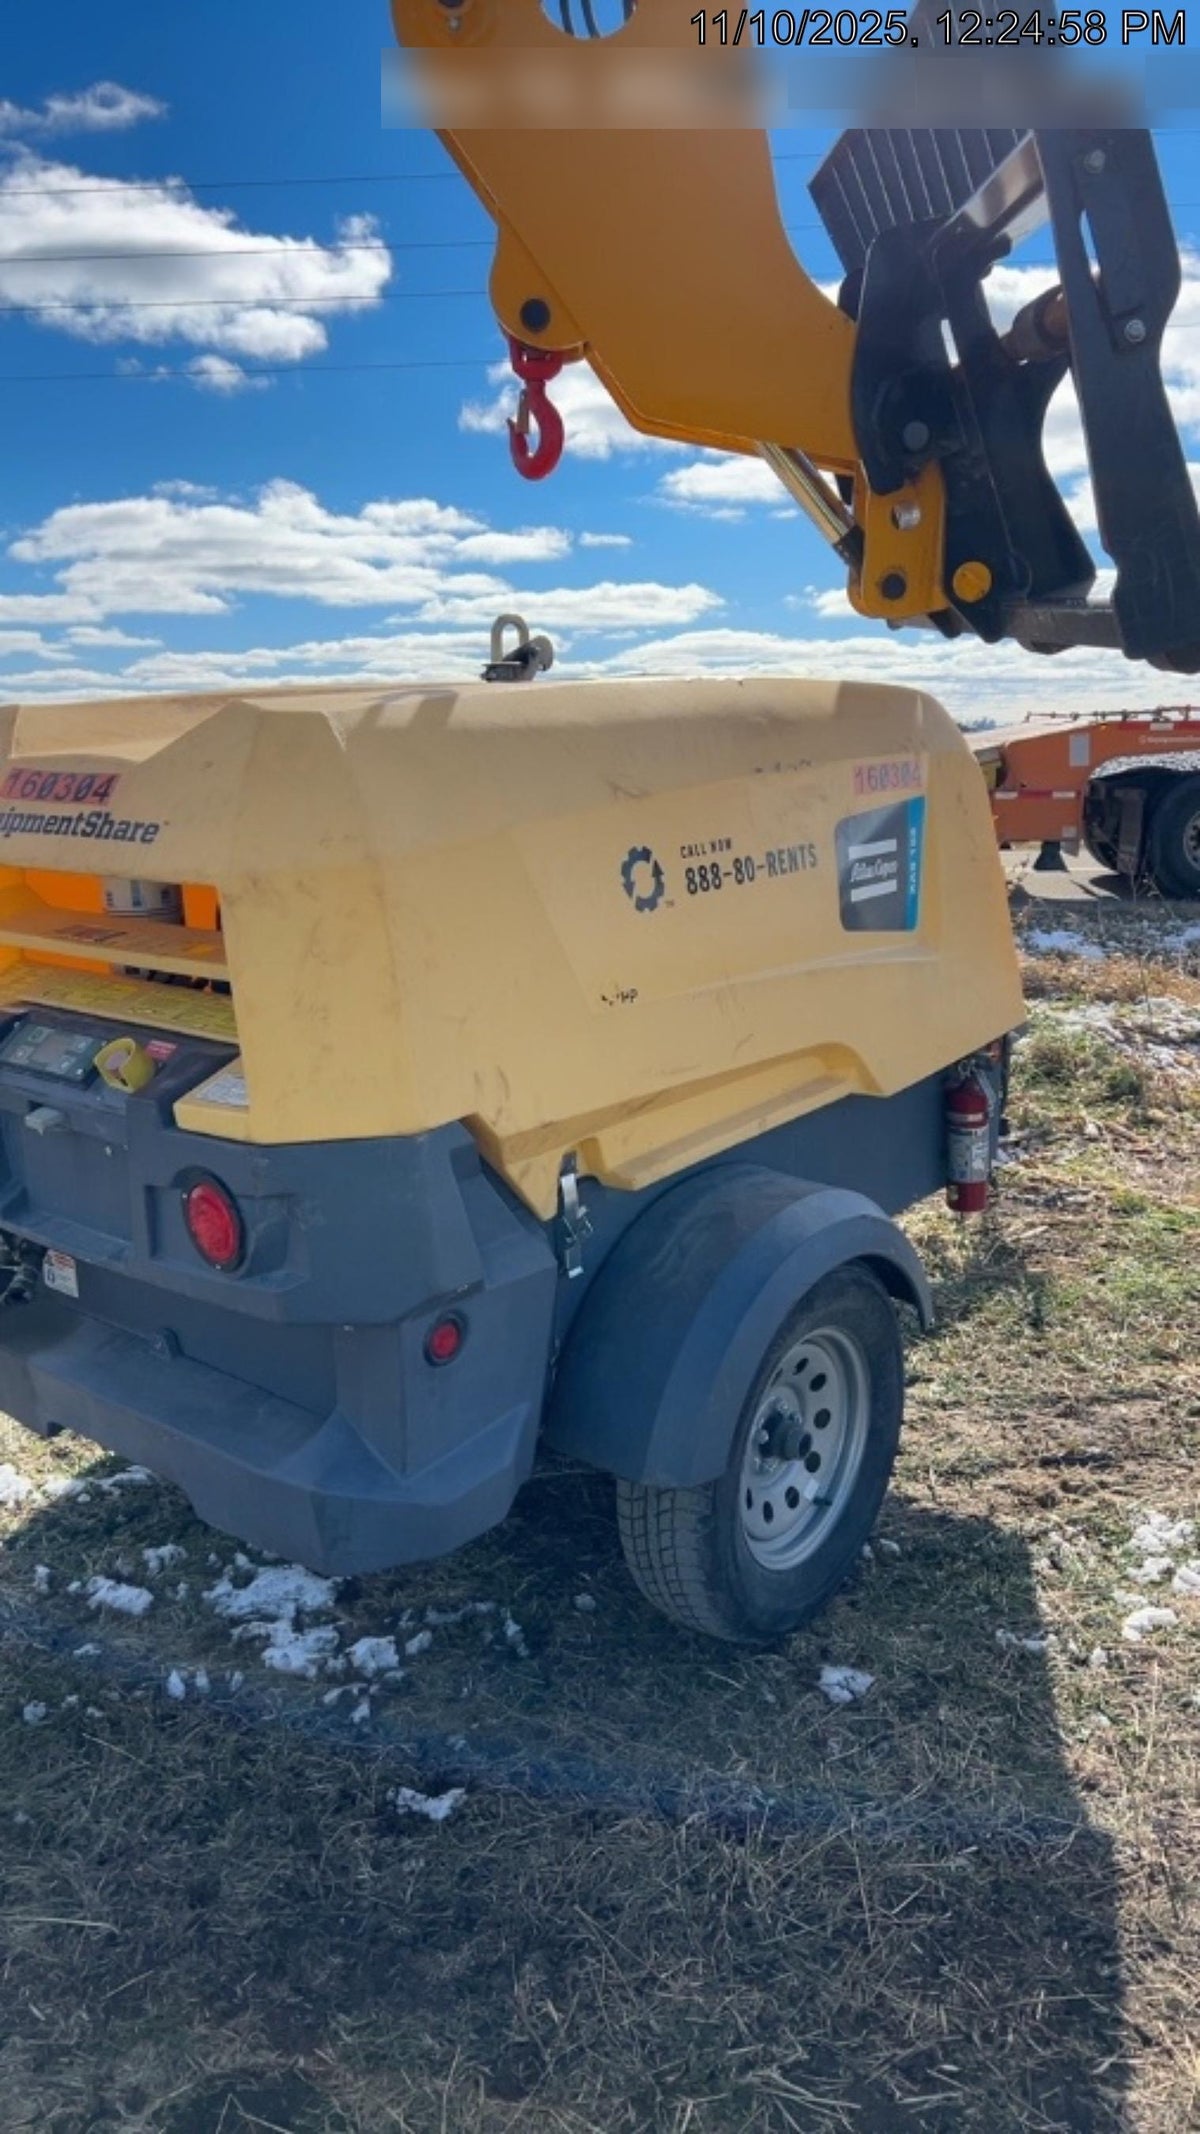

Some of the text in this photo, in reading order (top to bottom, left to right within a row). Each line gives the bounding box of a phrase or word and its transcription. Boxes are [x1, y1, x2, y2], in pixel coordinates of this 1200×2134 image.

[7, 768, 120, 803] 160304
[853, 760, 922, 796] 160304
[680, 843, 707, 859] CALL
[684, 842, 817, 895] 888-80-RENTS
